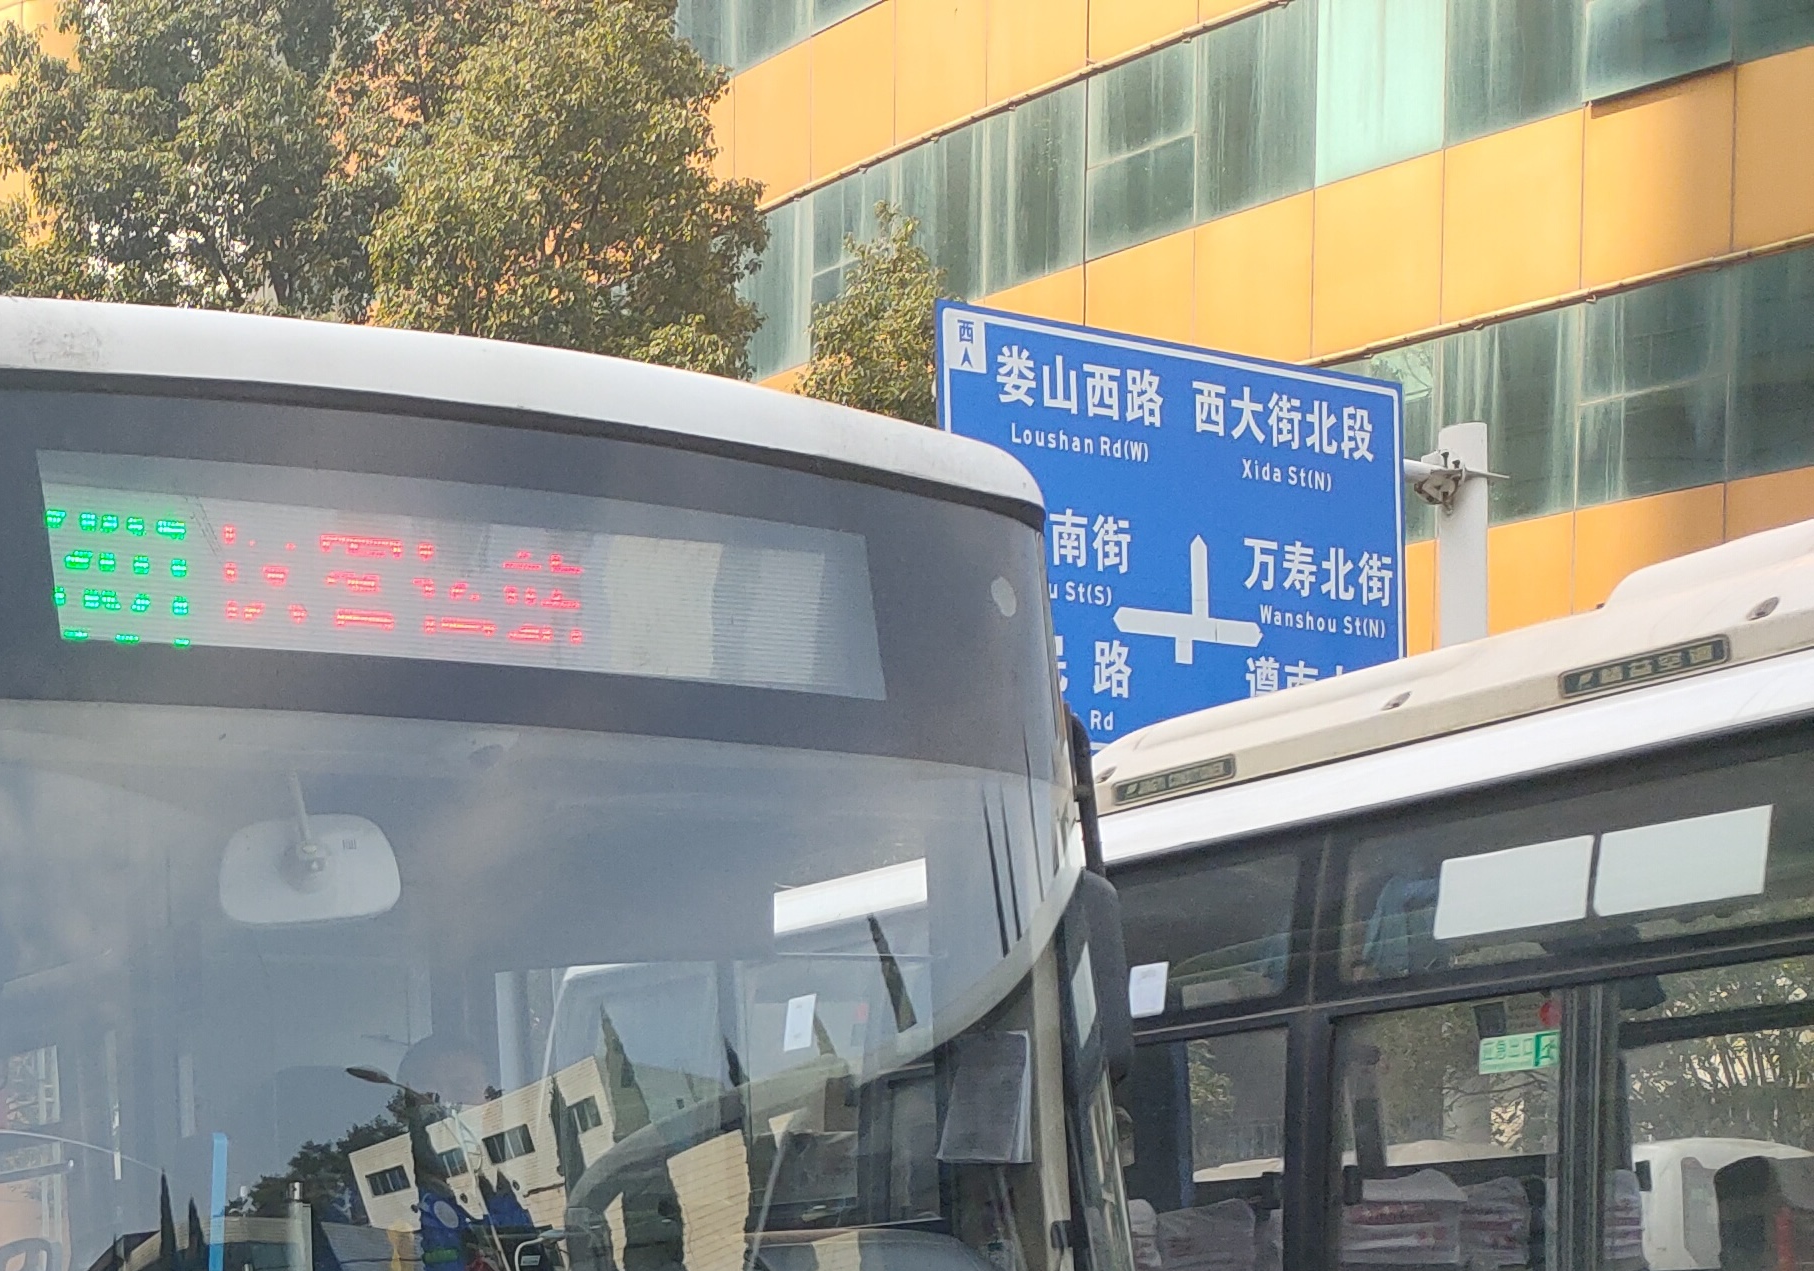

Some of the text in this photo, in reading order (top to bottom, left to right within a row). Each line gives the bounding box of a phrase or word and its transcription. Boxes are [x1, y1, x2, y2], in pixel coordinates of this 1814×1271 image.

[957, 319, 974, 344] 西
[996, 345, 1164, 427] 娄山西路
[1192, 381, 1374, 463] 西大街北段
[1011, 422, 1149, 462] Loushan Rd(W)
[1242, 458, 1332, 492] Xida St(N)
[1049, 508, 1131, 574] 南街
[1243, 537, 1393, 607] 万寿北街
[1065, 583, 1112, 606] St(S)
[1259, 605, 1386, 639] Wanshou St(N)
[1090, 709, 1115, 732] Rd
